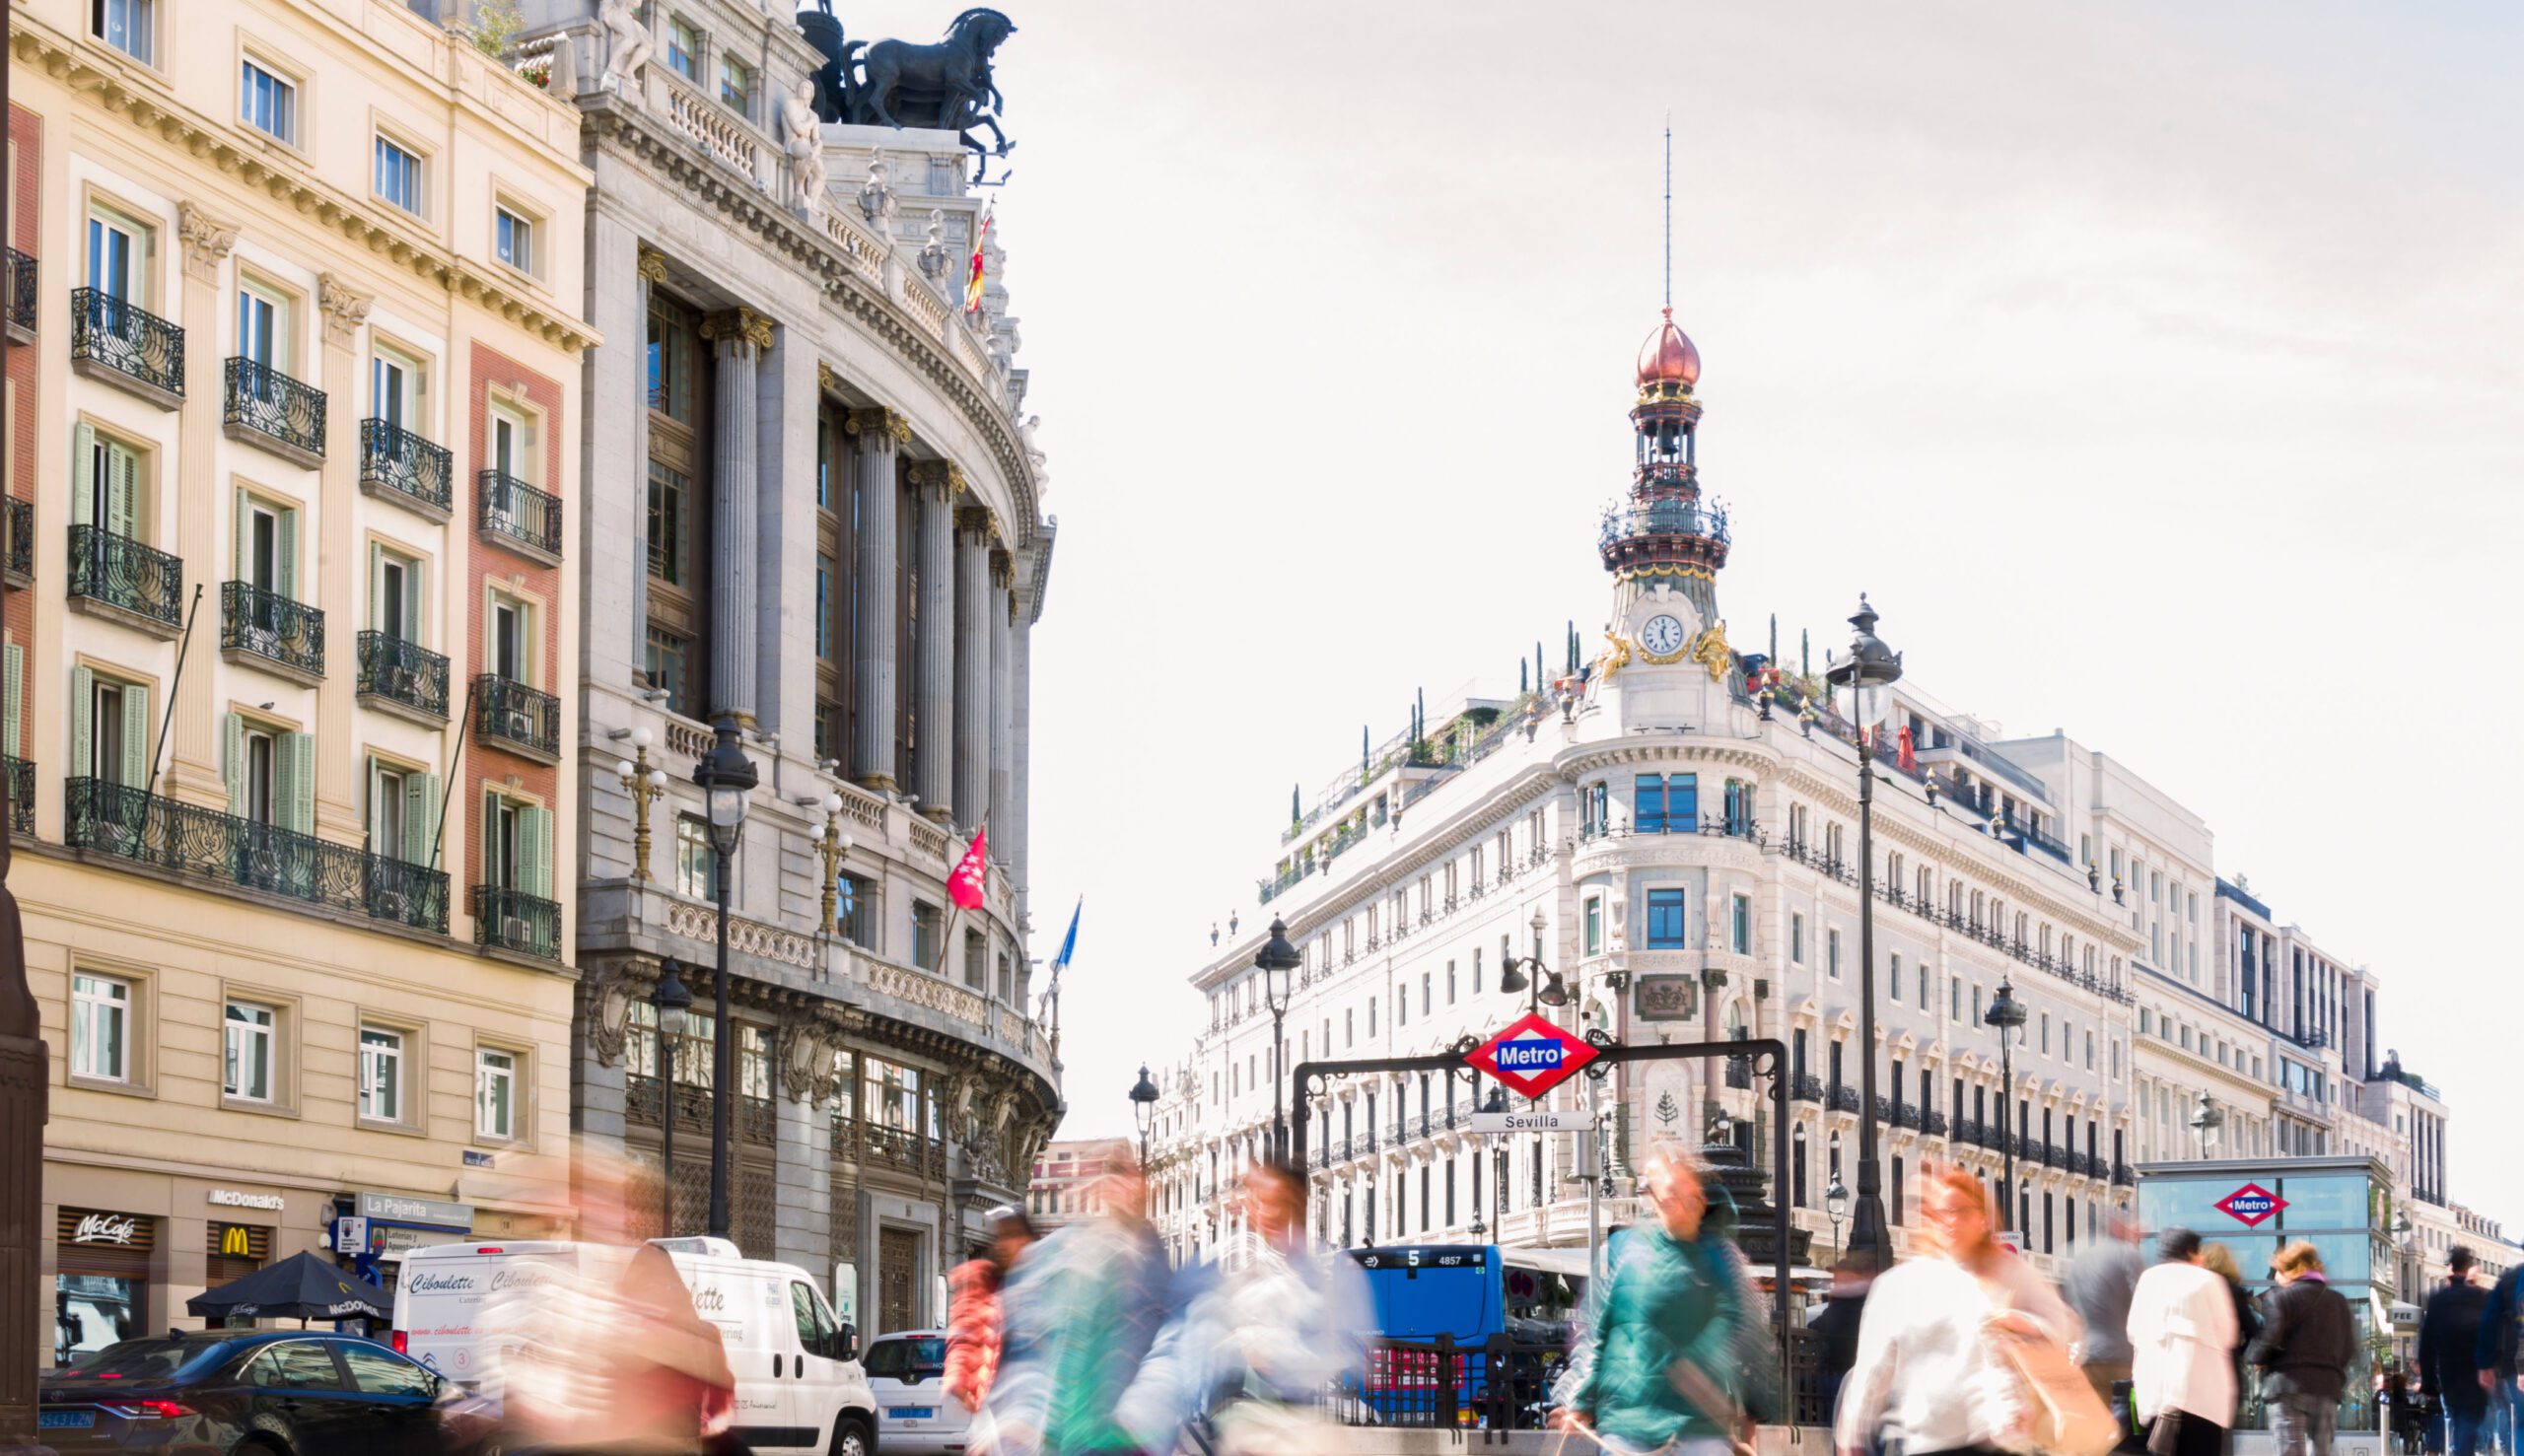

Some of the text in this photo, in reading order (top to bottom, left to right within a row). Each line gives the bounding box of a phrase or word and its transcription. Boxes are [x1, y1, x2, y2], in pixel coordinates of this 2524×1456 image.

[1501, 1047, 1558, 1065] Metro
[1506, 1116, 1558, 1128] Sevilla
[214, 1190, 284, 1211] McDonald's
[368, 1197, 382, 1213] La
[384, 1199, 427, 1218] Pajarita
[2234, 1200, 2269, 1211] Metro
[77, 1213, 135, 1243] McCafé
[1408, 1250, 1419, 1266] 5
[1438, 1256, 1461, 1265] 4857
[410, 1274, 474, 1293] Ciboulette
[457, 1353, 465, 1365] 3
